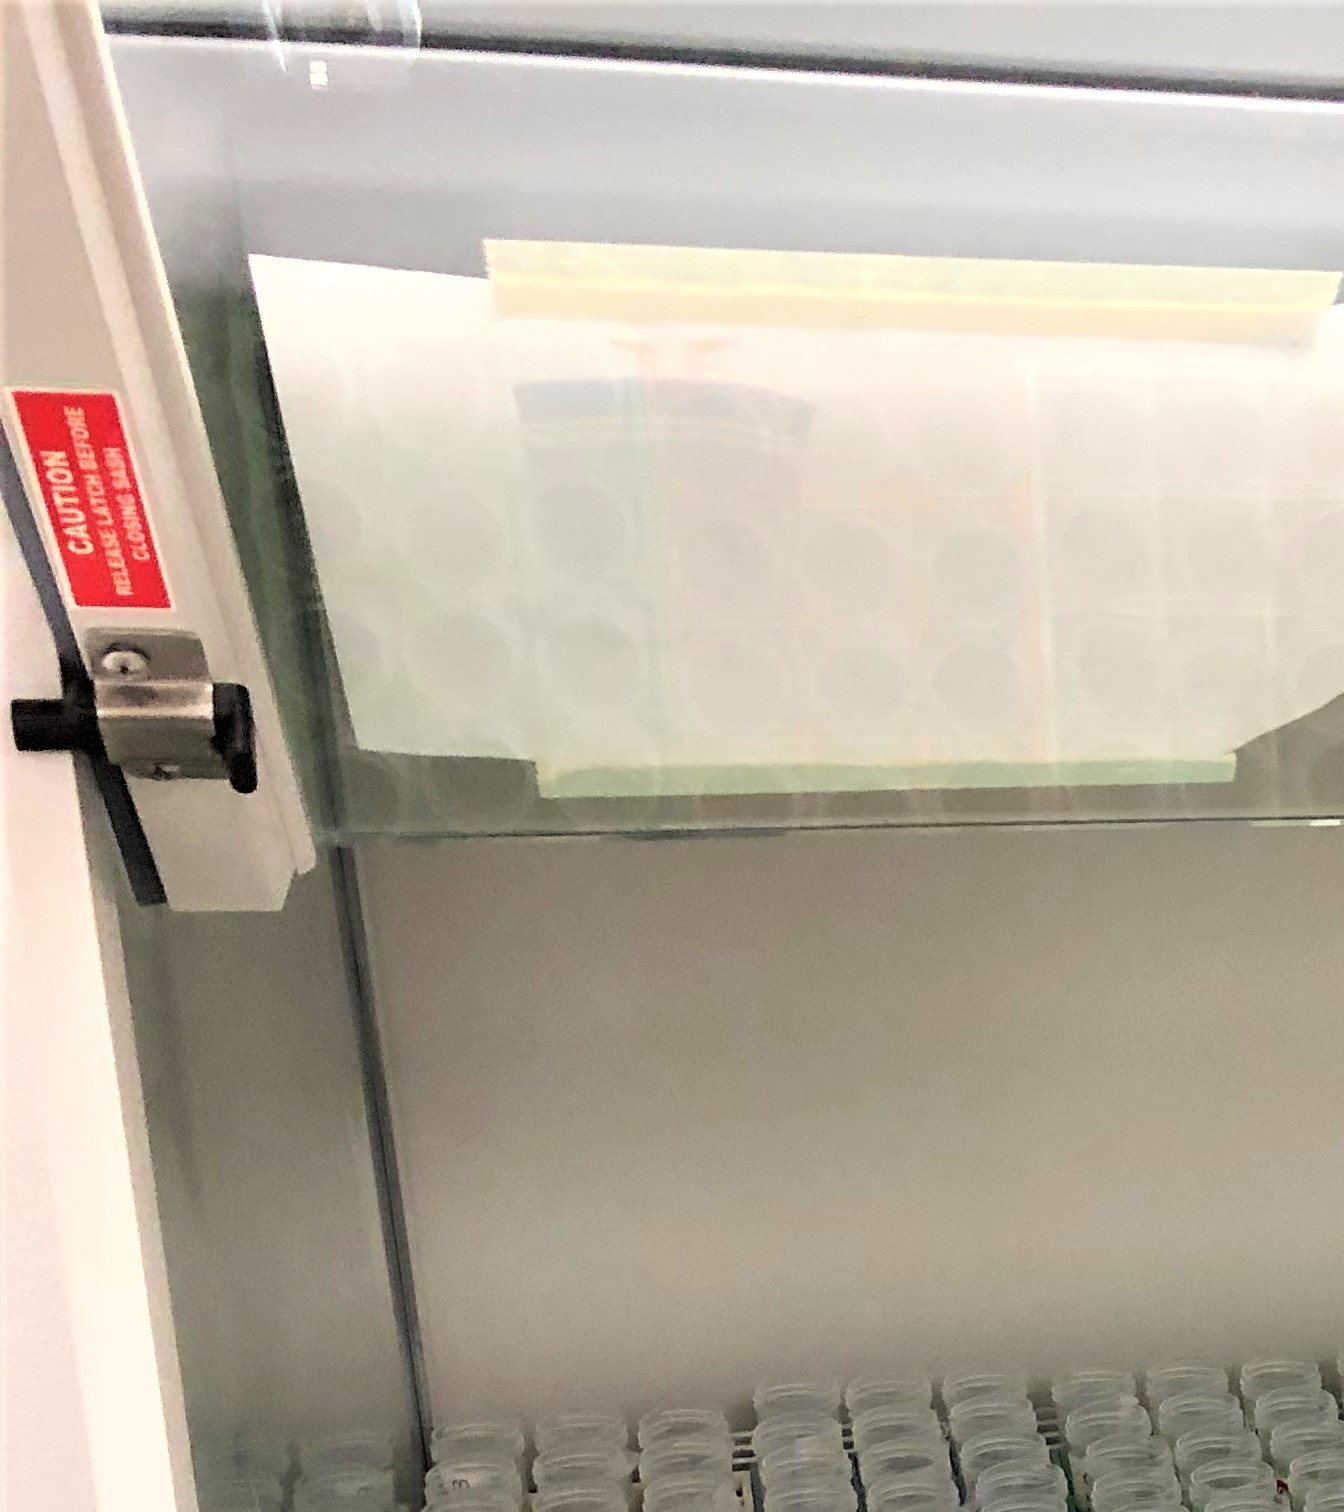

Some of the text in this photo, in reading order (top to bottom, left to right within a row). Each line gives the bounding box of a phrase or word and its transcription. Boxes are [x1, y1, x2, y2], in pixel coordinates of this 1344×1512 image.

[40, 450, 94, 555] CAUTION
[64, 406, 133, 595] RELEASE LATCH BEFORE
[102, 447, 150, 560] CLOSING SASH
